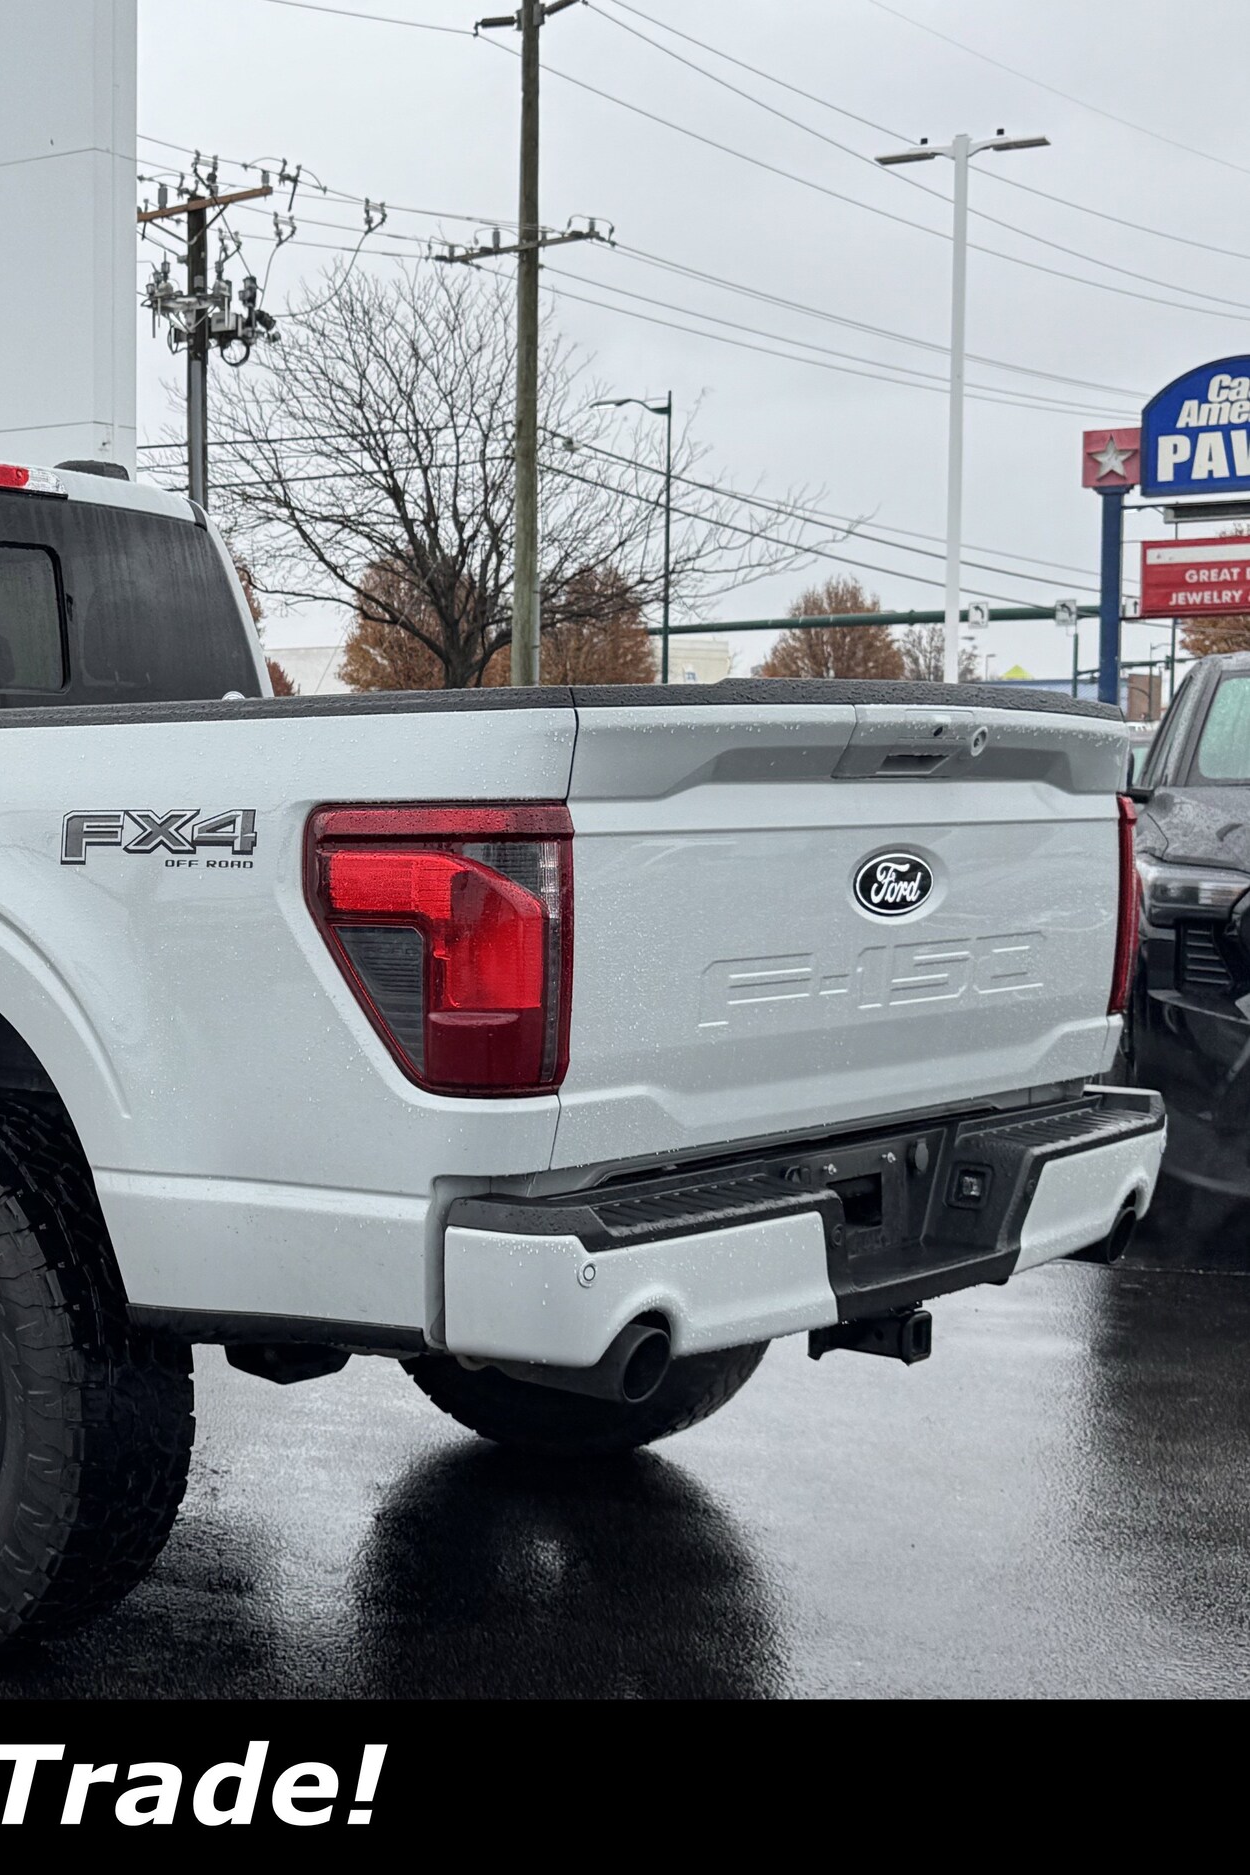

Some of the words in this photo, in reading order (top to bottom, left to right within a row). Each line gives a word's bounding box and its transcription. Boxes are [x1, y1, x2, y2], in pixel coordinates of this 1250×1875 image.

[1207, 373, 1250, 403] Ca
[1176, 399, 1250, 428] Ame
[1185, 568, 1241, 583] GREAT
[1169, 589, 1243, 606] JEWELRY
[60, 808, 257, 866] FX4
[164, 858, 200, 869] OFF
[205, 859, 254, 870] ROAD
[871, 861, 922, 904] Ford
[699, 930, 1046, 1028] F-150
